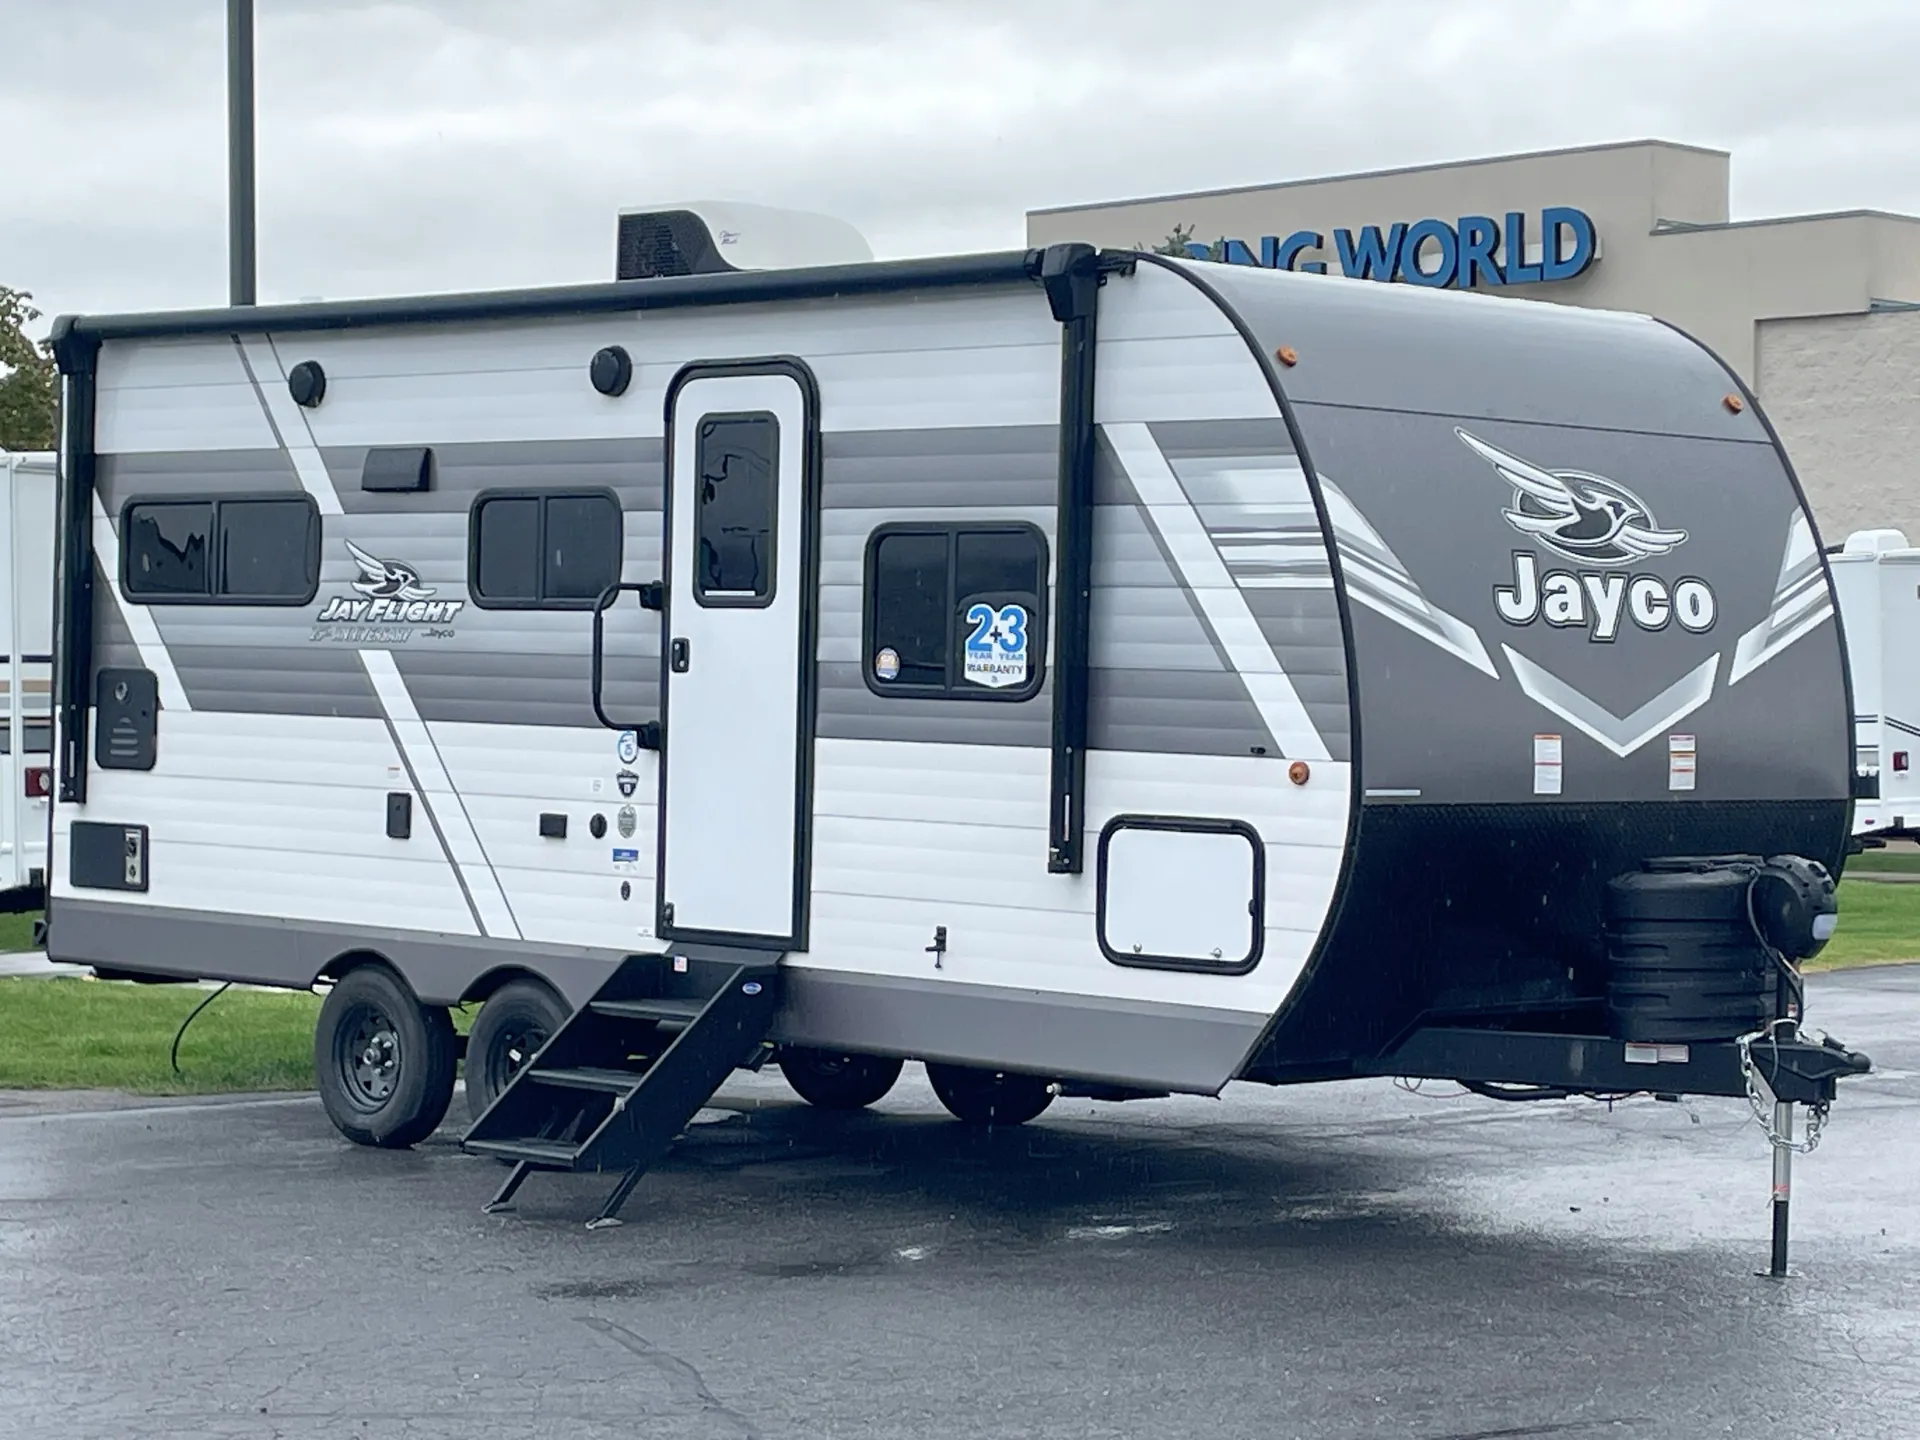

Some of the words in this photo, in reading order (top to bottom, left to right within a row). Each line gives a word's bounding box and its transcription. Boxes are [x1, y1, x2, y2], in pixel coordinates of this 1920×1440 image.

[1333, 206, 1598, 290] WORLD
[317, 596, 369, 623] JAY
[365, 597, 465, 624] FLIGHT
[1494, 550, 1717, 642] Jayco
[967, 663, 1024, 675] WARRANTY
